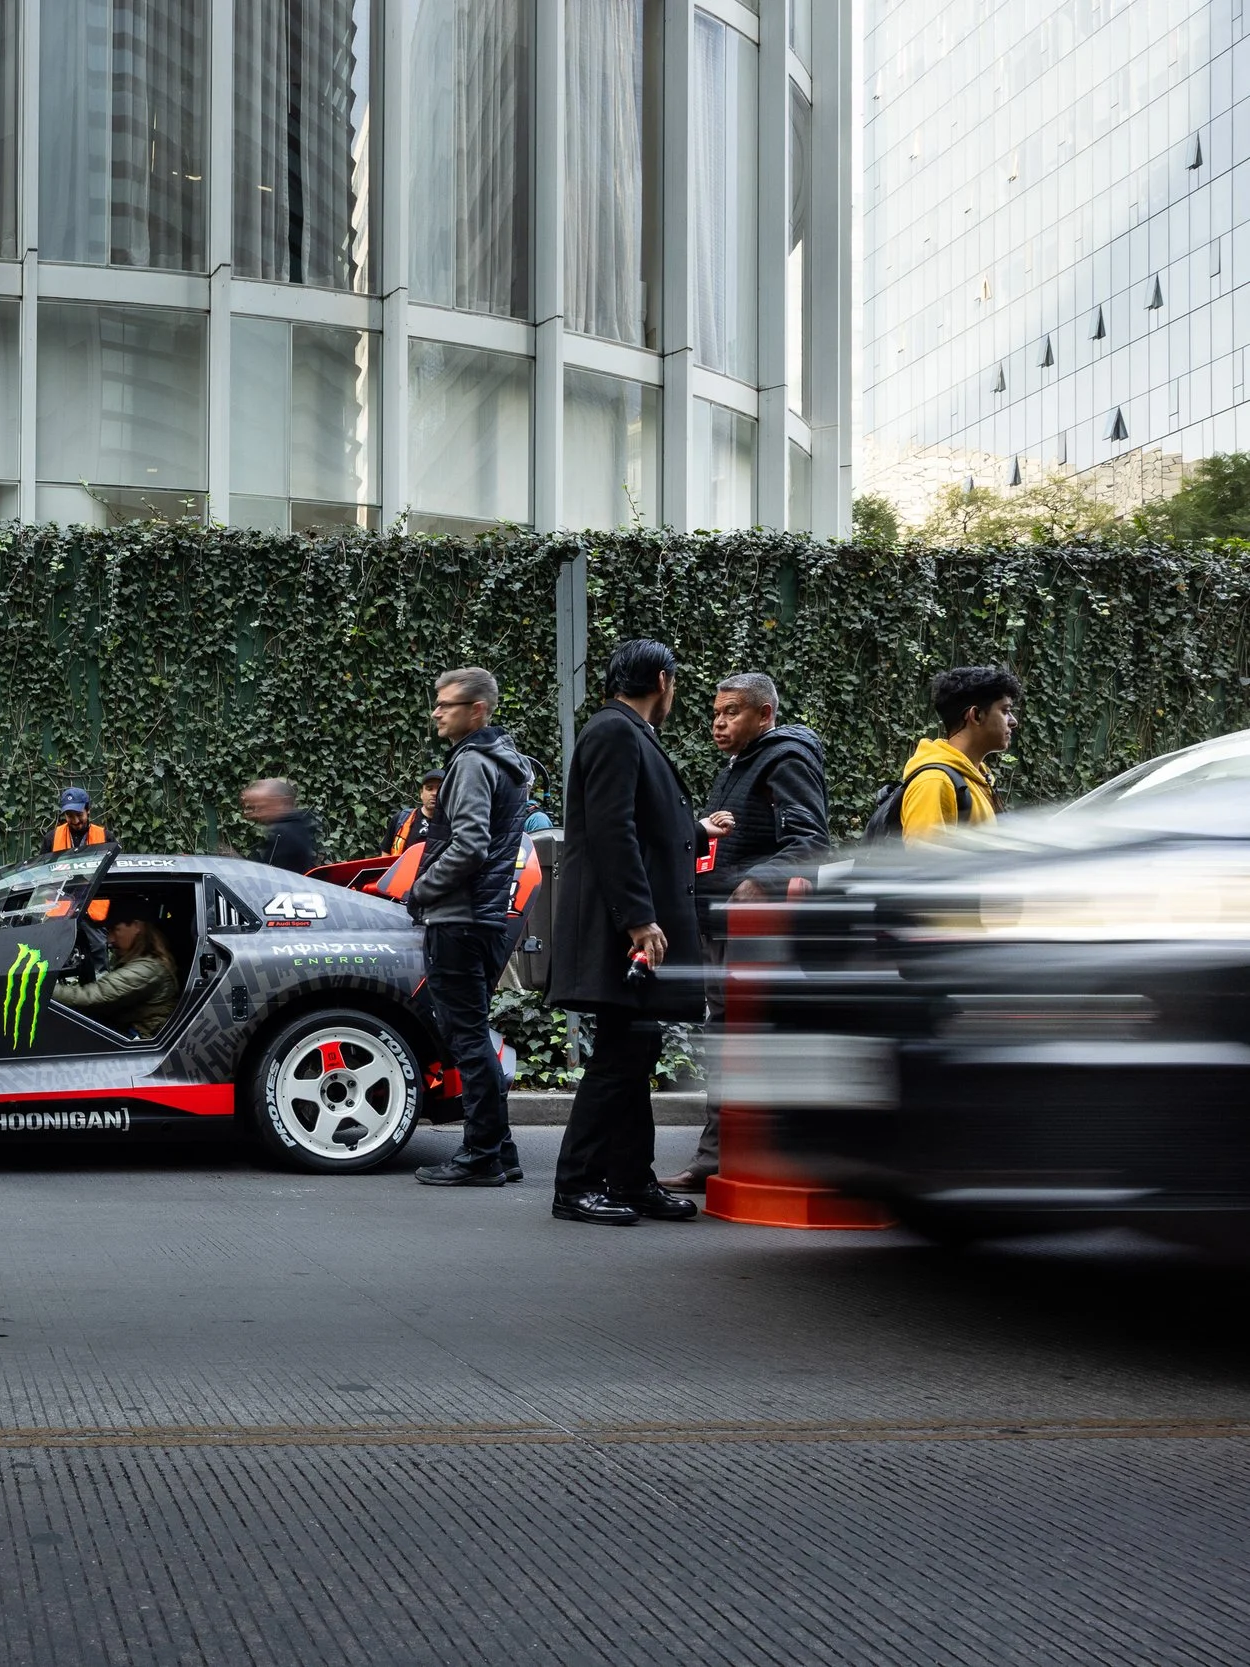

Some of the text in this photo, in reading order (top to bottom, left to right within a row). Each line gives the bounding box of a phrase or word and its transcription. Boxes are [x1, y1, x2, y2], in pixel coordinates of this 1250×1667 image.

[263, 891, 327, 919] 43
[293, 956, 378, 966] ENERGY
[265, 1059, 297, 1148] PROXES
[377, 1030, 417, 1144] TOYO TIRES
